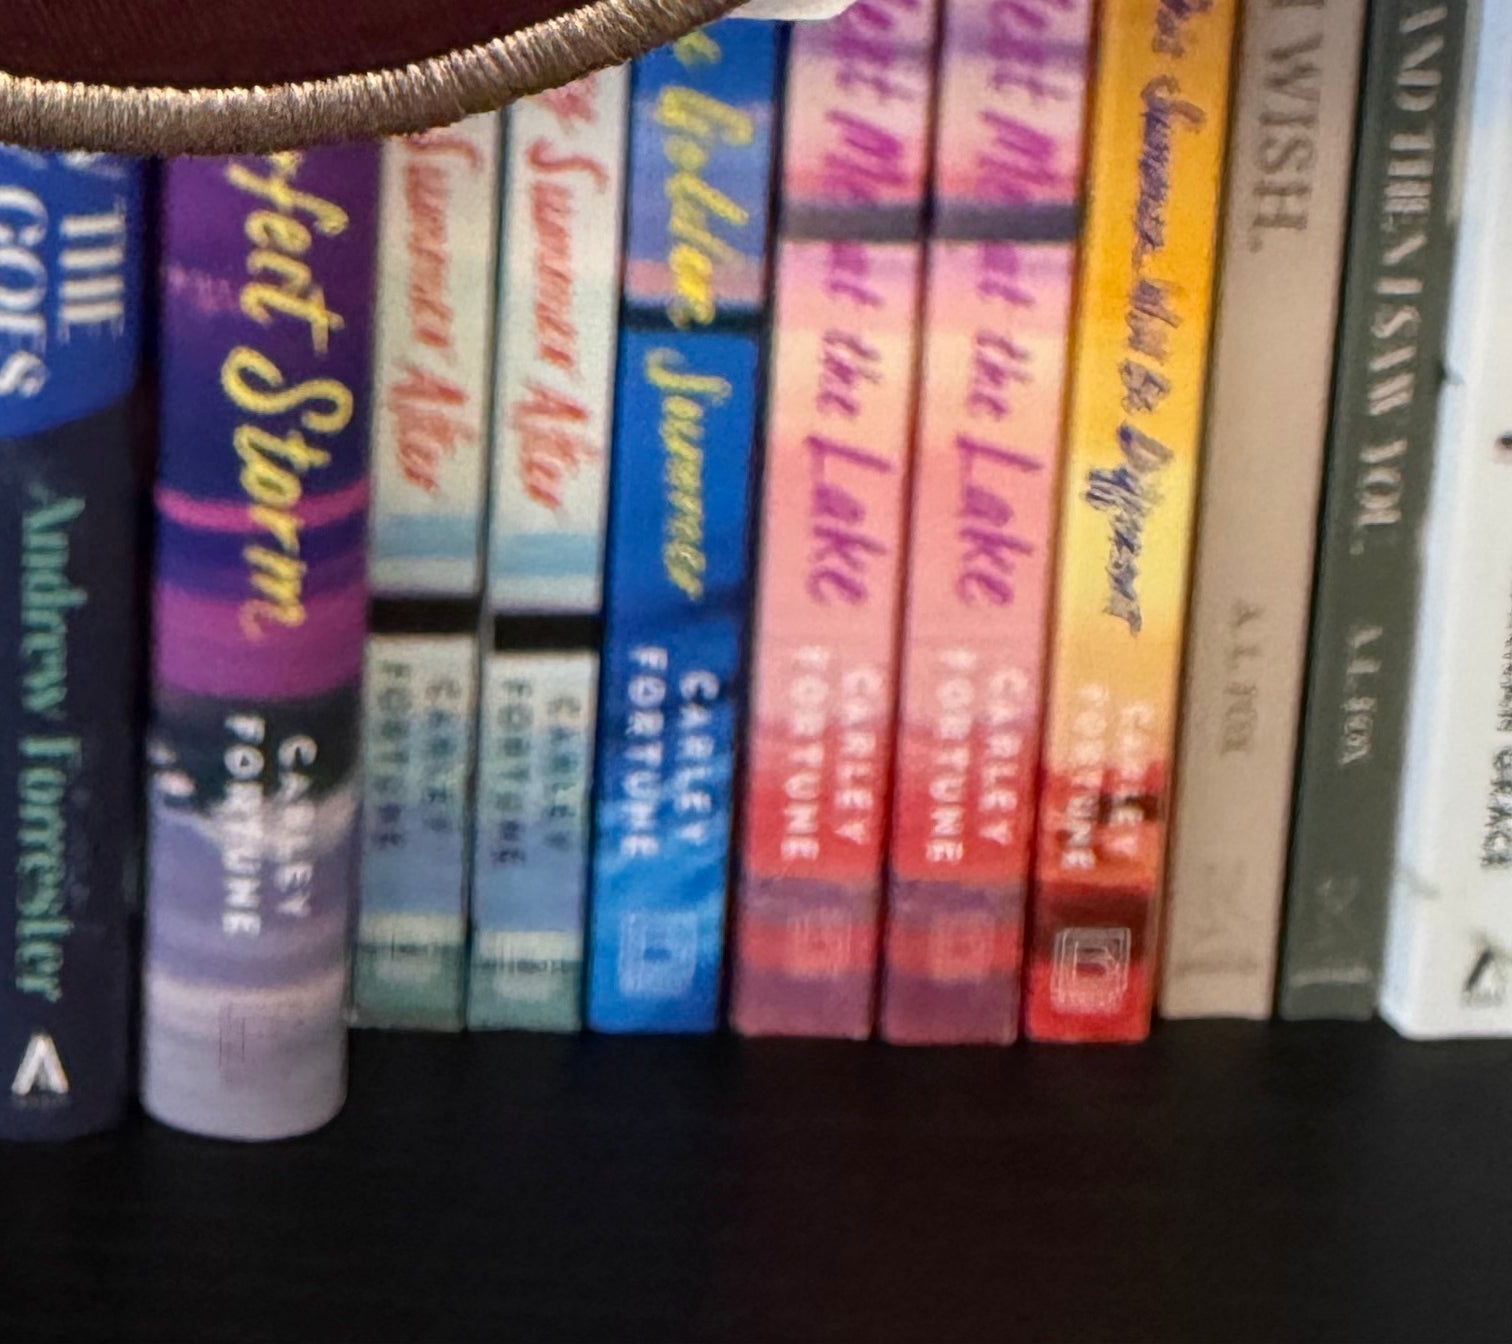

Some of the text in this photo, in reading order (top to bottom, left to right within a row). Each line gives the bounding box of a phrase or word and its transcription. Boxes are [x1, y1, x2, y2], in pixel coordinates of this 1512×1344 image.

[1248, 29, 1323, 254] WISH.
[1394, 3, 1449, 113] AND
[655, 87, 755, 328] Golden
[822, 110, 905, 206] Me
[978, 111, 1058, 206] Me
[1131, 74, 1208, 271] Summer
[1382, 130, 1434, 268] THEN
[57, 195, 128, 344] THE
[388, 132, 484, 499] Summer After
[525, 138, 610, 374] Summer
[828, 240, 884, 307] at
[977, 240, 1036, 308] at
[1124, 278, 1184, 364] Will
[1376, 276, 1422, 296] I
[512, 376, 600, 512] After
[819, 330, 882, 417] the
[969, 330, 1033, 421] the
[1118, 358, 1170, 415] Be
[1366, 308, 1422, 417] SAW
[221, 345, 354, 642] Storm
[645, 348, 732, 600] Summer
[804, 434, 899, 608] Lake
[957, 432, 1044, 608] Lake
[1081, 423, 1174, 638] Different
[18, 481, 88, 720] Andrew
[222, 715, 266, 938] FORTUNE
[275, 735, 319, 918] CARLEY
[621, 647, 668, 859] FORTUNE
[675, 669, 719, 846] CARLEY
[780, 646, 831, 862] FORTUNE
[833, 667, 885, 848] CARLEY
[926, 649, 977, 865] FORTUNE
[977, 668, 1029, 848] CARLEY
[15, 735, 82, 1003] Forrester
